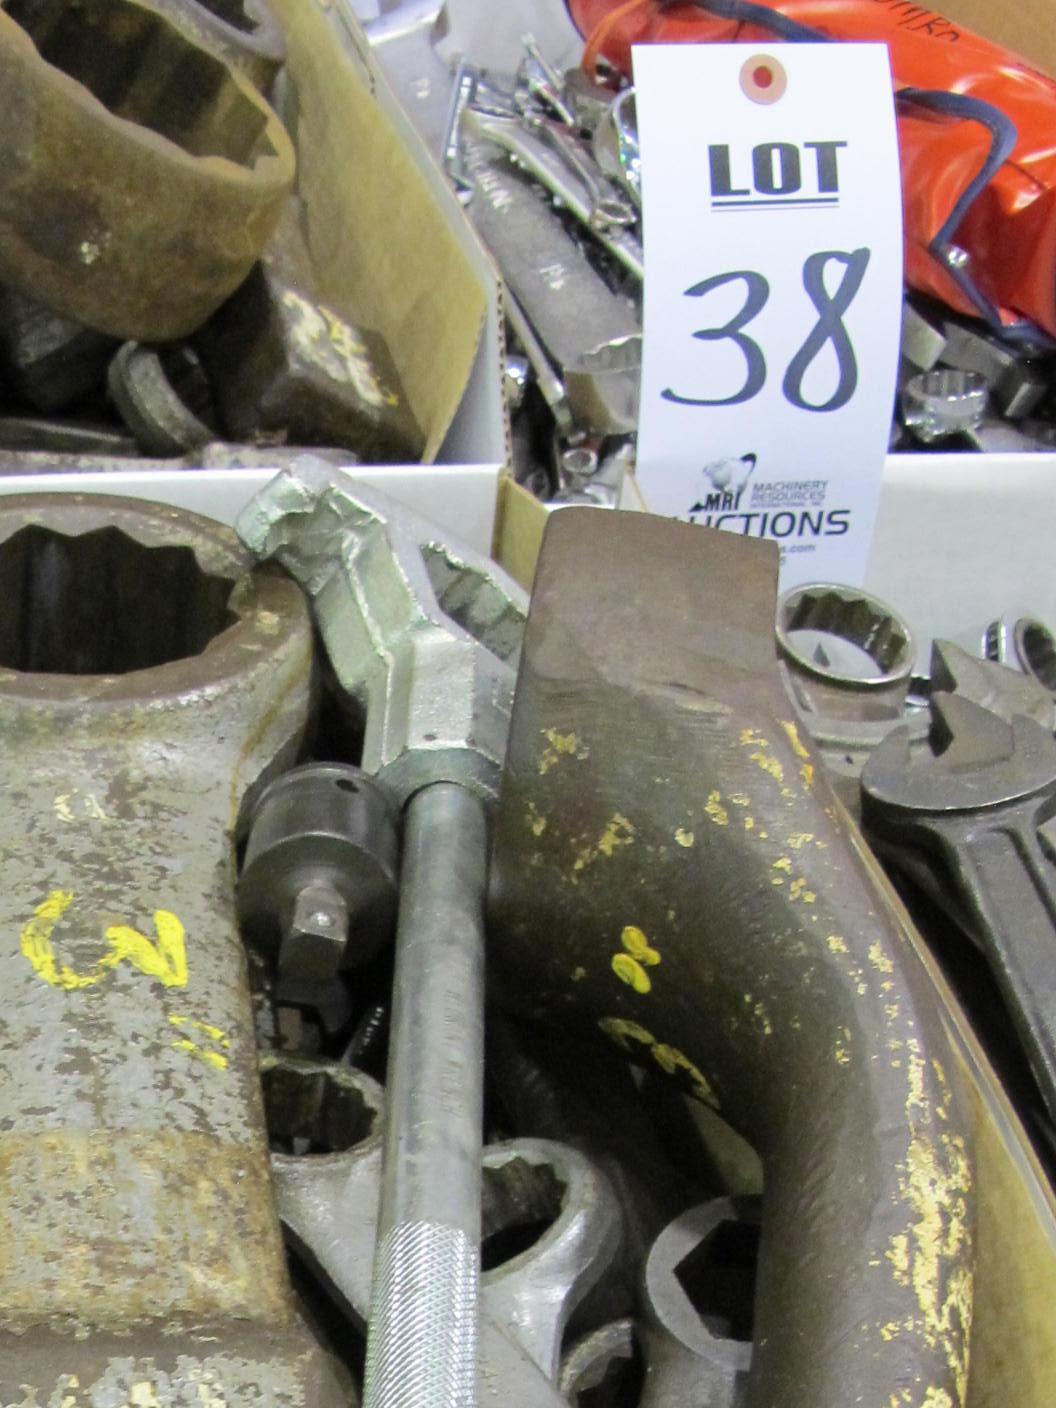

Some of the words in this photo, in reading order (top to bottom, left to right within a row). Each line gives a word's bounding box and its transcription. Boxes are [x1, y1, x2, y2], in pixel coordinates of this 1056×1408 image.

[707, 141, 848, 196] LOT
[660, 246, 872, 414] 38
[704, 490, 742, 512] MRI
[752, 479, 830, 492] MACHINERY
